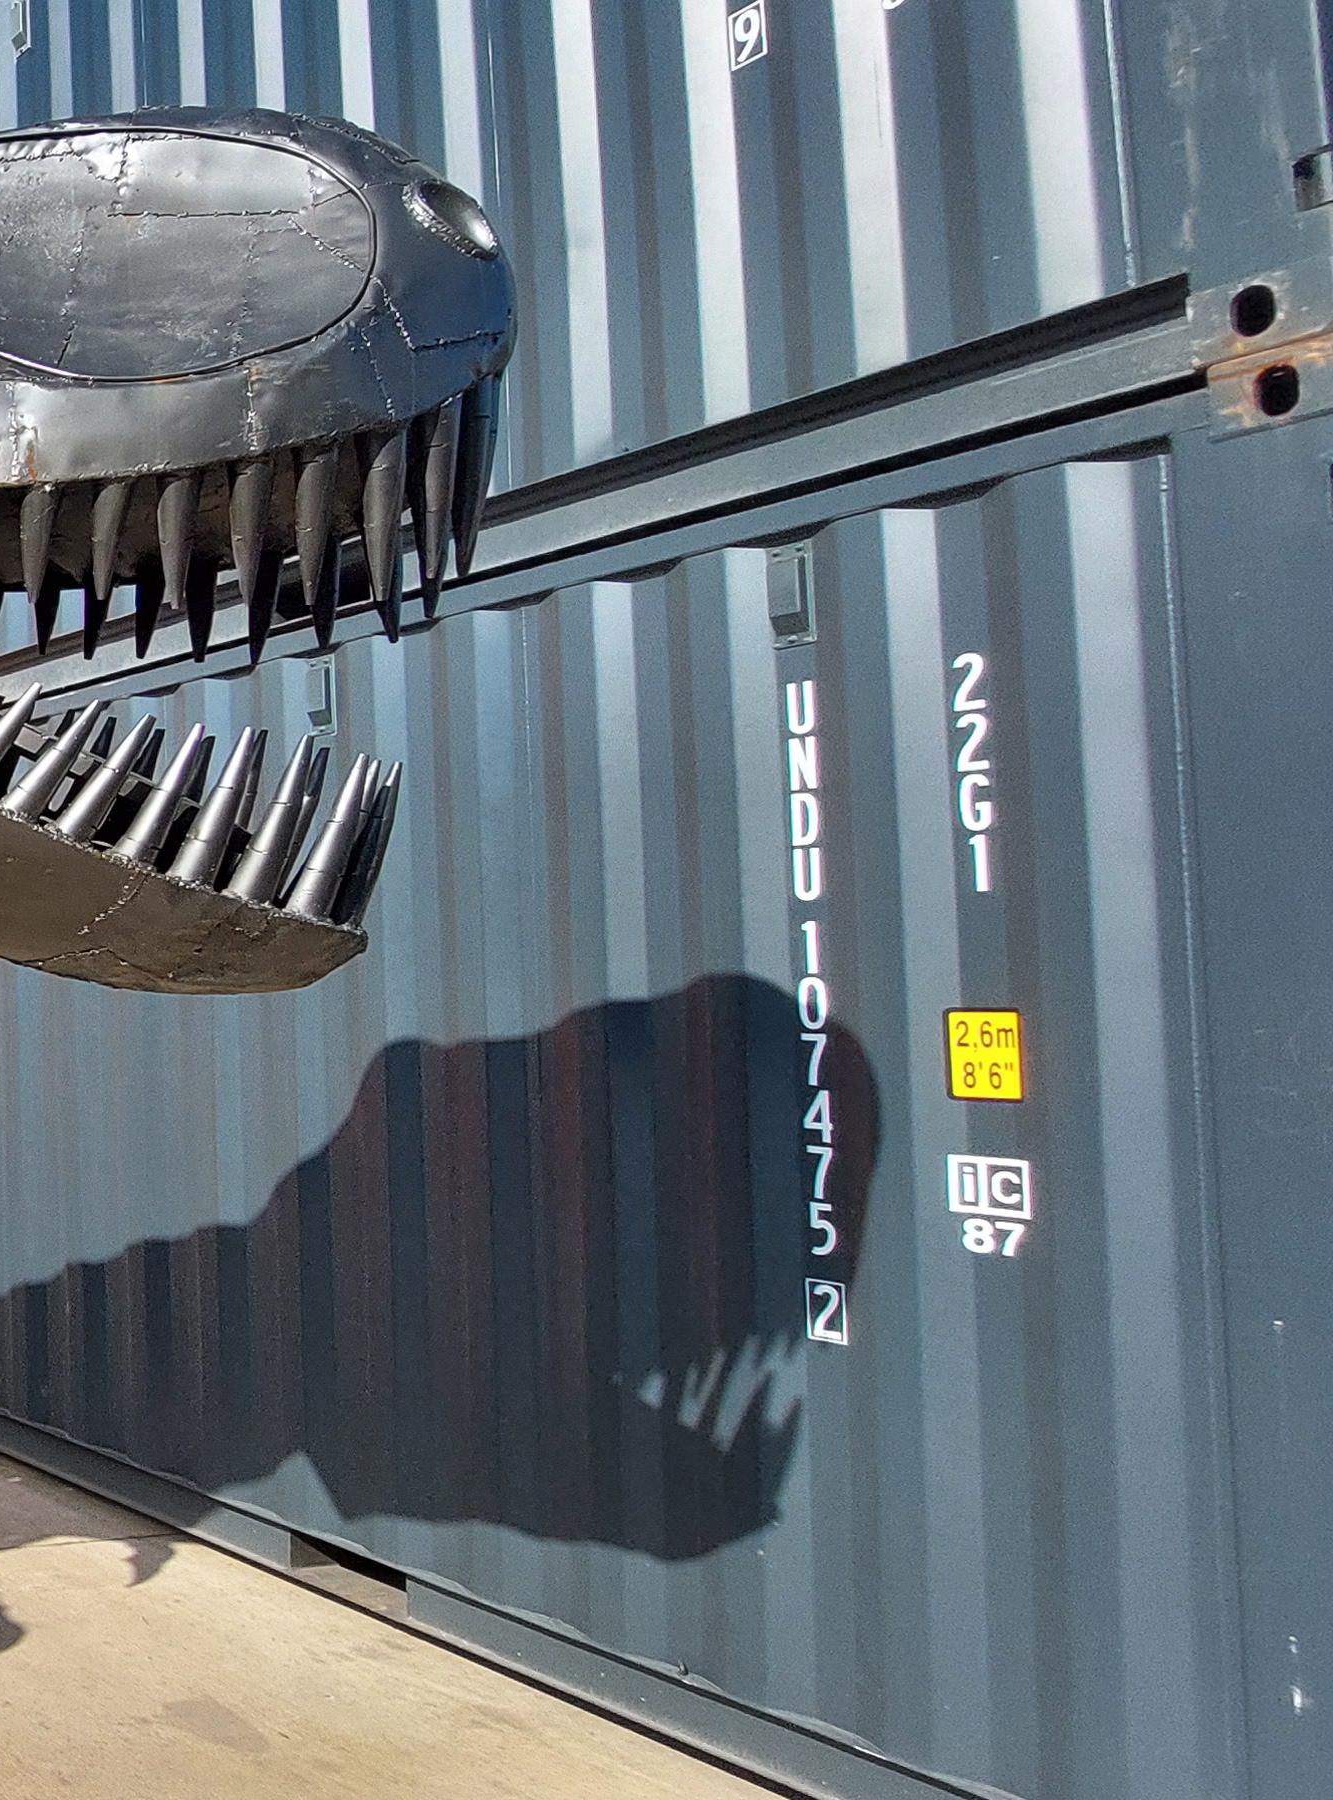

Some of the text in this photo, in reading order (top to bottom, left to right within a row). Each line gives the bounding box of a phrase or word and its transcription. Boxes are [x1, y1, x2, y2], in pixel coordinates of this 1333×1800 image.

[735, 9, 760, 62] 9
[952, 653, 992, 892] 22G1
[786, 680, 843, 1341] UNDU 107475 2
[955, 1019, 1016, 1054] 2,6m
[961, 1219, 1026, 1257] 87
